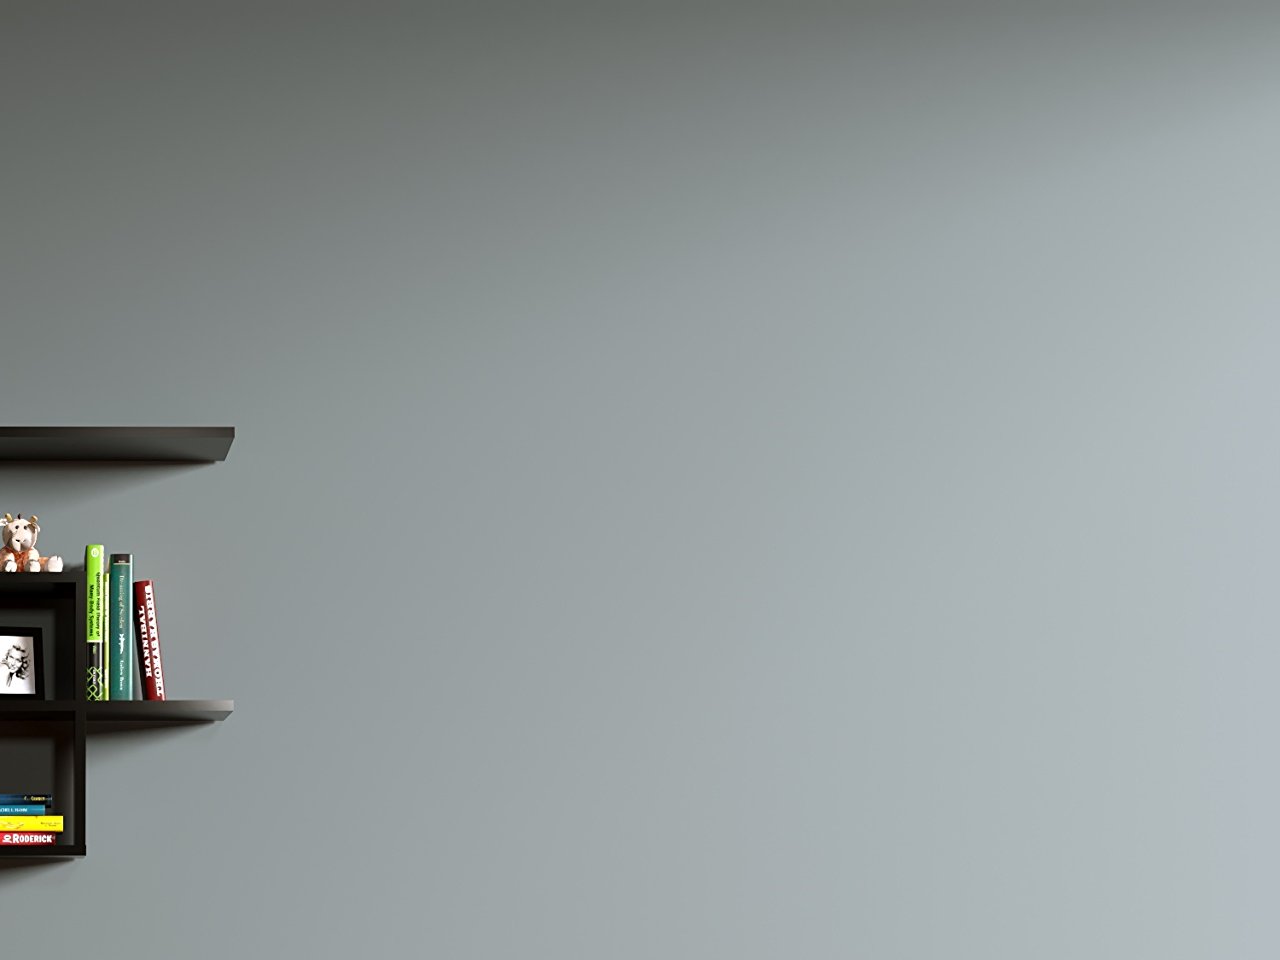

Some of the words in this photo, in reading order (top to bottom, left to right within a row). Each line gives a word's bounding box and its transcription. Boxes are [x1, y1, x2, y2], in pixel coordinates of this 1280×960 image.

[145, 585, 159, 639] HARRIS
[138, 605, 152, 678] HANNIBAL
[151, 640, 165, 697] THOMAS
